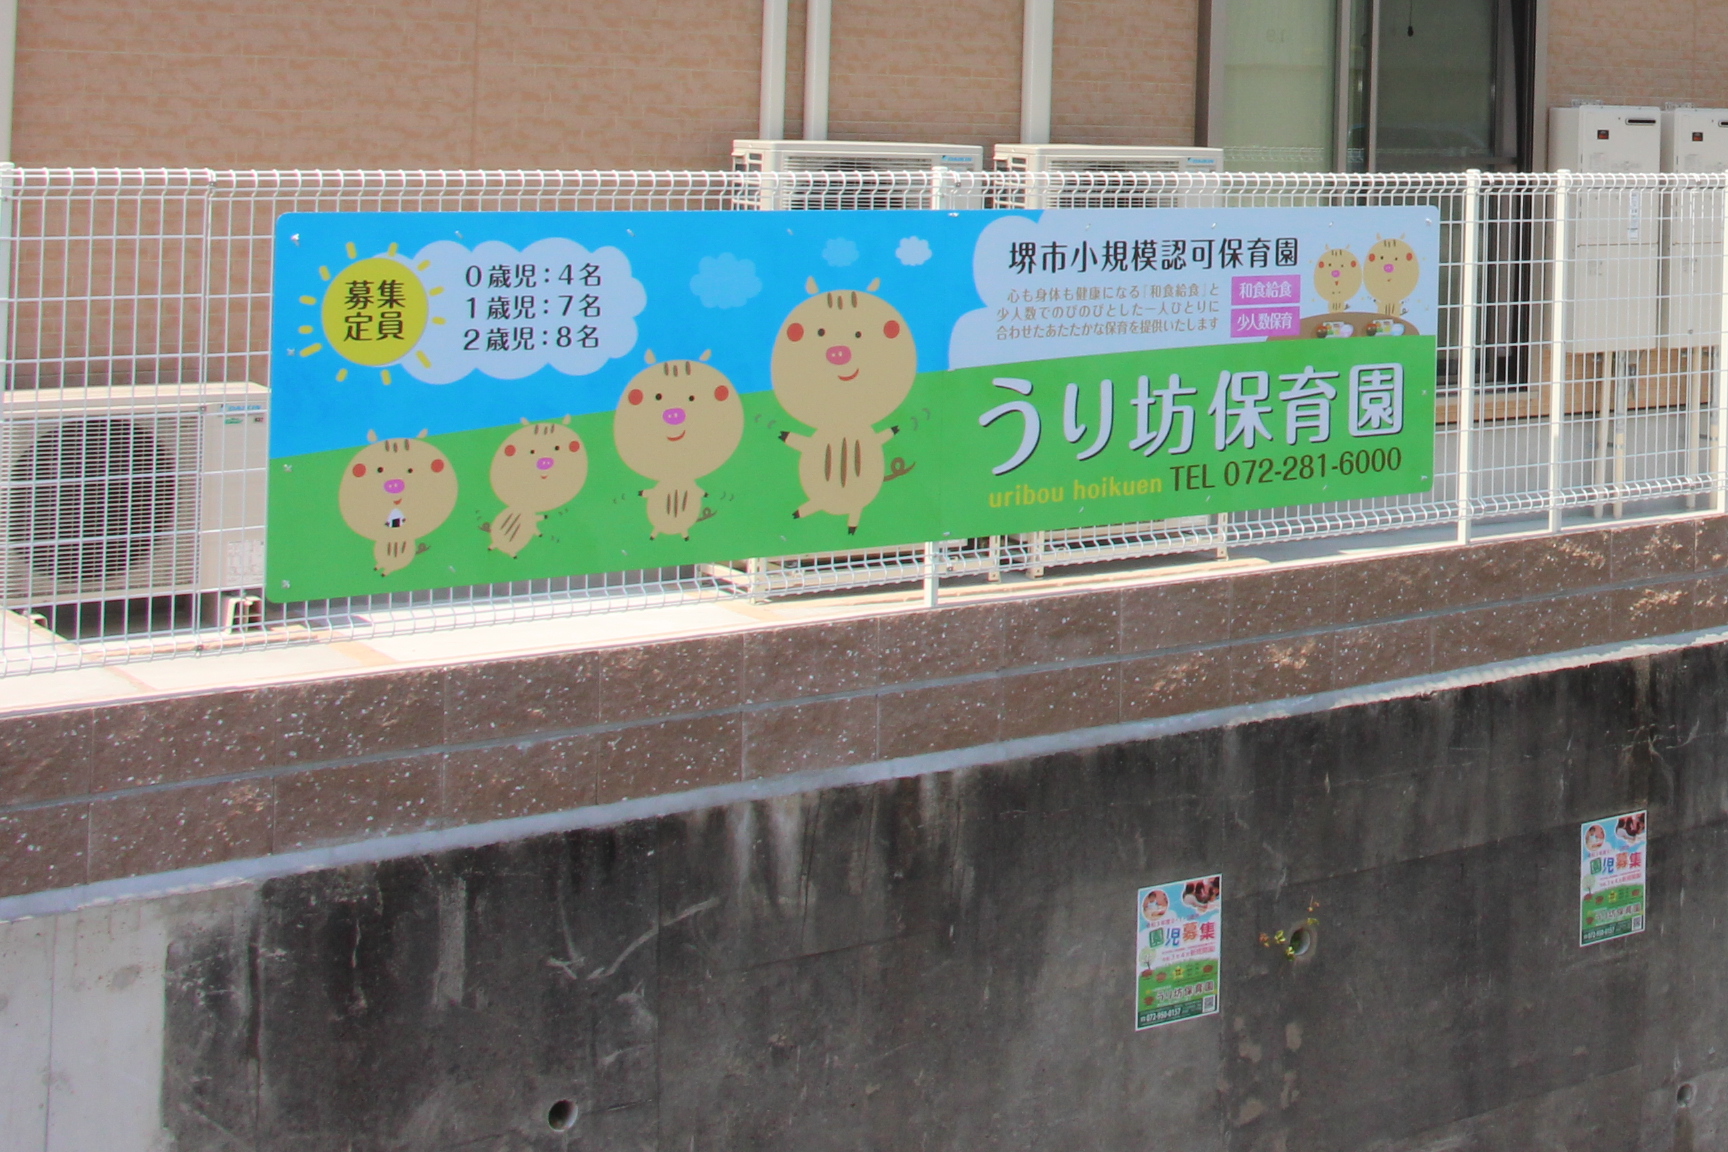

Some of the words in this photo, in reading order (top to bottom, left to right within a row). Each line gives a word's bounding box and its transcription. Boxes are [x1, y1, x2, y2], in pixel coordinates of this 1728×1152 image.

[1008, 237, 1298, 275] 堺市小規模認可保育園
[344, 279, 406, 310] 募集
[1238, 280, 1292, 300] 和食給食
[343, 310, 406, 342] 定員
[996, 316, 1219, 341] 合わせたあたたかな保育を提供いたします
[1237, 312, 1292, 331] 少人数保育
[978, 363, 1405, 476] うり坊保育園
[1170, 465, 1216, 492] TEL
[1224, 446, 1402, 488] 072-281-6000
[988, 483, 1064, 509] uribou
[1073, 476, 1163, 502] hoikuen
